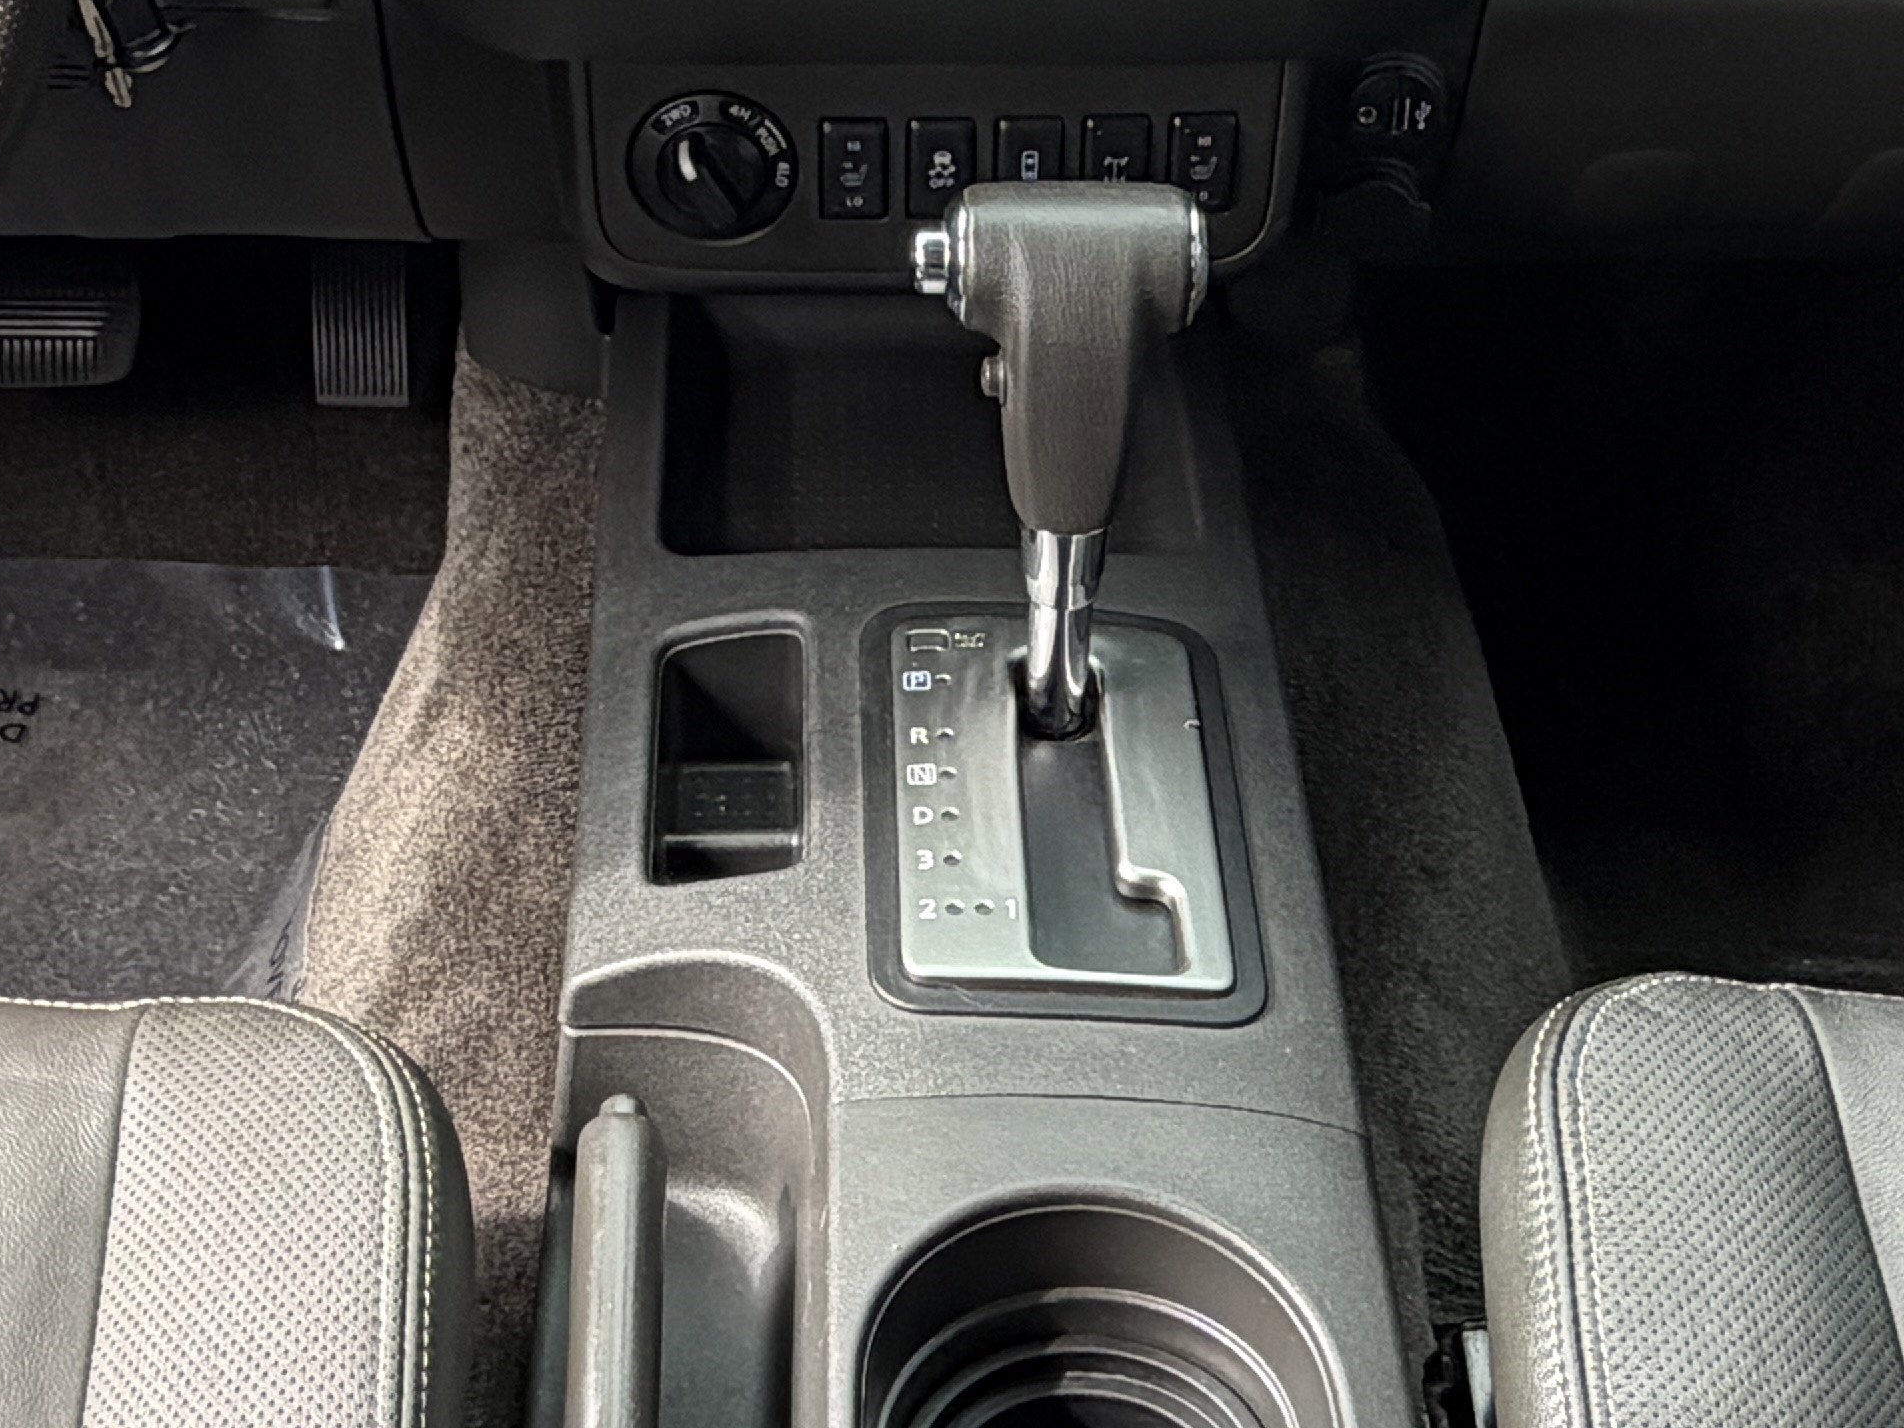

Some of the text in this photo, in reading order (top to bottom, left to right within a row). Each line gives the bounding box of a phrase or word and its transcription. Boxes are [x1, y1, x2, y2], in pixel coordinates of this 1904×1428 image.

[910, 726, 928, 744] R
[909, 764, 935, 783] N
[913, 806, 934, 825] D
[916, 849, 934, 870] 3
[918, 898, 937, 919] 2
[1006, 898, 1017, 919] 1
